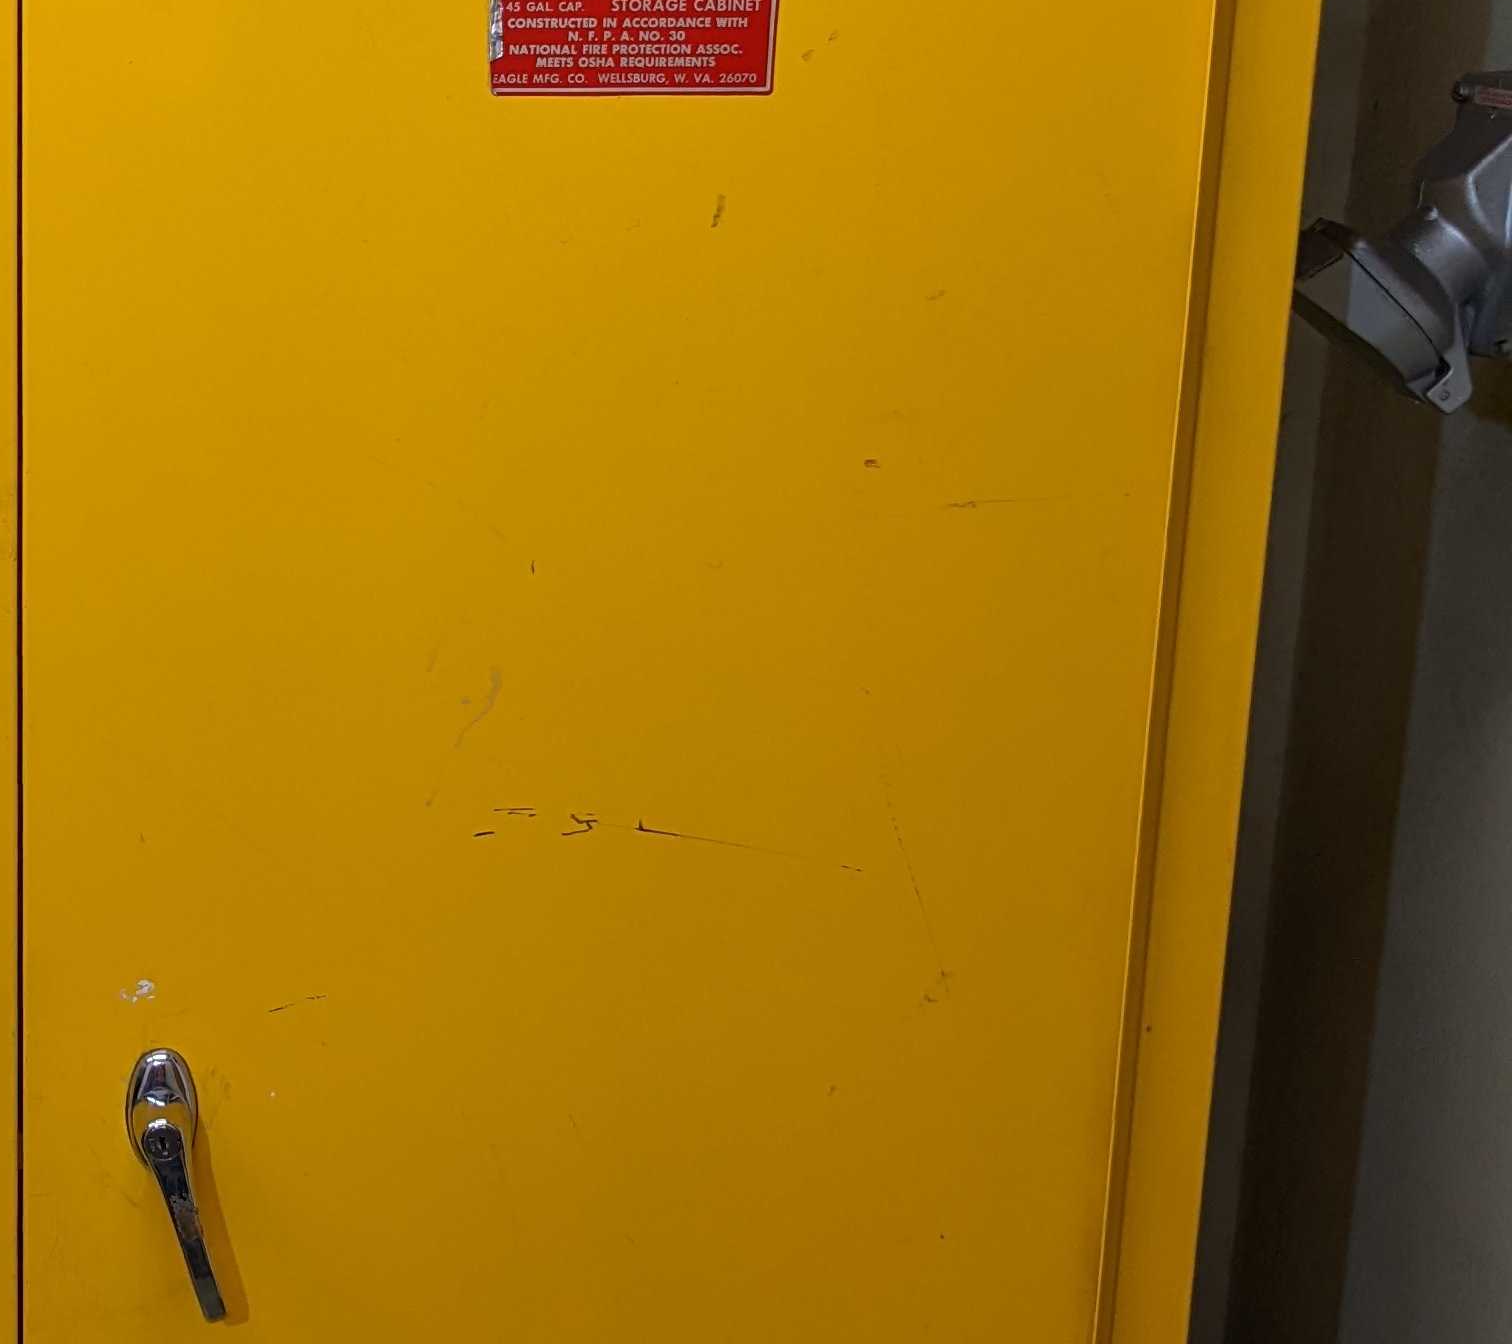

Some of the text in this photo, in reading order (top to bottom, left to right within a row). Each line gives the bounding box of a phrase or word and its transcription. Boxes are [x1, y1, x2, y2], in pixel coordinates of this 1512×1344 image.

[506, 2, 520, 12] 45
[558, 2, 584, 12] CAP.
[507, 17, 748, 29] CONSTRUCTED IN ACCORDANCE WITH
[568, 31, 686, 42] N. F. P. A. NO. 30
[509, 44, 743, 55] NATIONAL FIRE PROTECTION ASSOC.
[536, 57, 716, 68] MEETS OSHA REQUIREMENTS
[493, 73, 757, 85] EAGLE MFG. CO. WELLSBURG, W. VA. 26070
